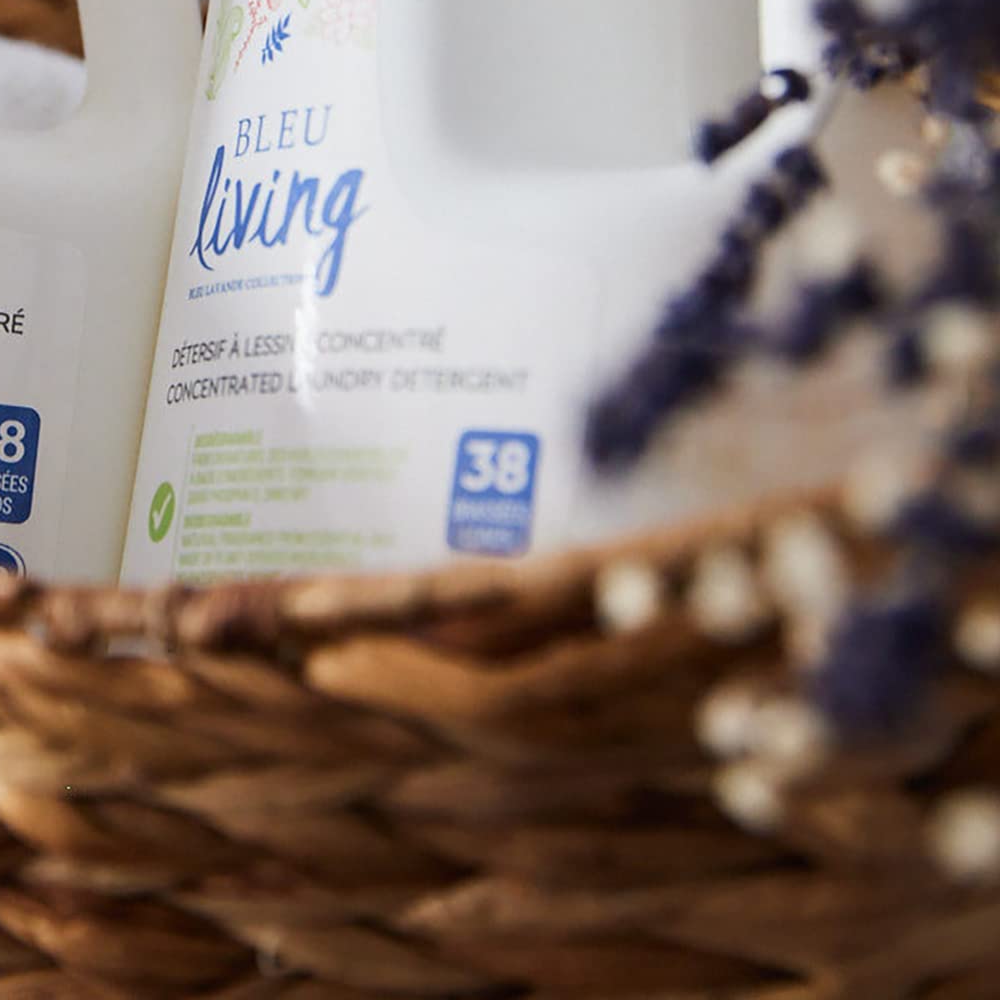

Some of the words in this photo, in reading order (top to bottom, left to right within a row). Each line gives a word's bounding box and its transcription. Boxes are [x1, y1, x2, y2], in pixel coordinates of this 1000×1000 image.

[234, 104, 333, 158] BLEU
[189, 145, 372, 298] living
[171, 339, 228, 369] DÉTERSIF
[166, 371, 282, 405] CONCENTRATED
[460, 439, 531, 494] 38
